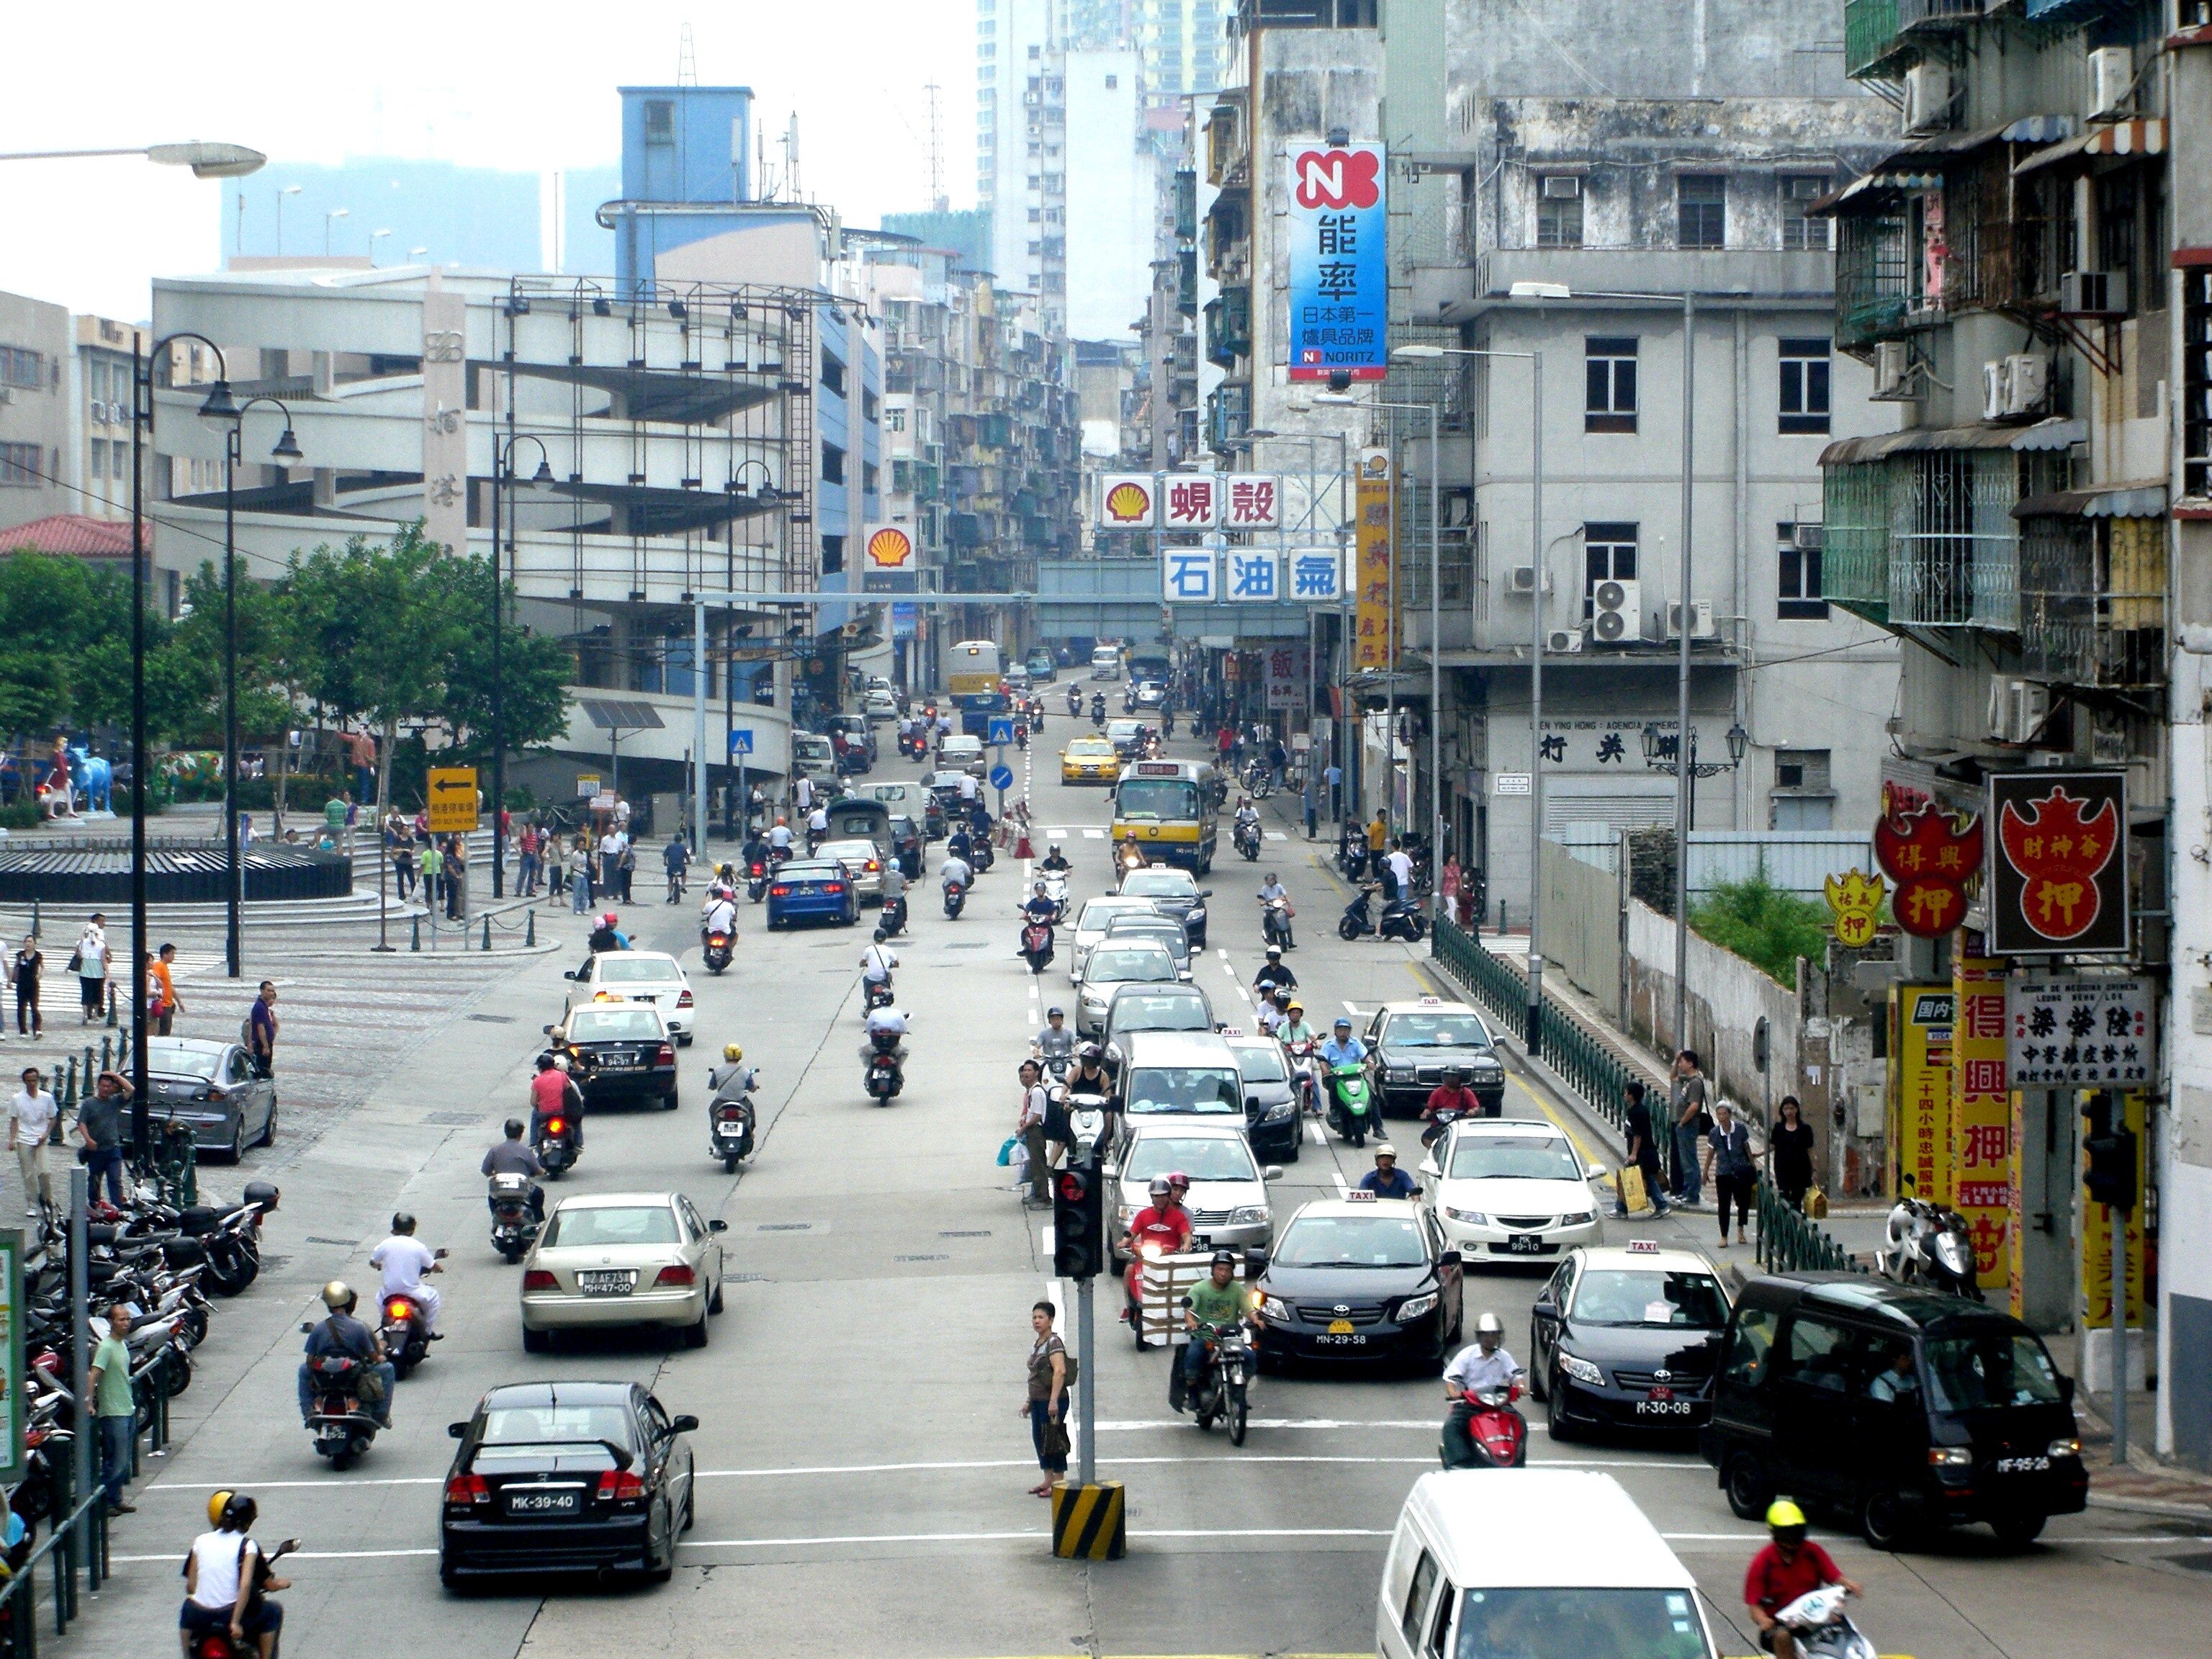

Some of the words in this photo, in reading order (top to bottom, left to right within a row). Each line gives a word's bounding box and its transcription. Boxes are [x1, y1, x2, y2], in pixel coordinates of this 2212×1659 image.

[1306, 161, 1341, 199] N
[1318, 215, 1357, 301] 能率
[1303, 307, 1374, 323] 日本第一
[1302, 328, 1374, 346] 爐具品牌
[1304, 352, 1313, 361] N
[1326, 351, 1375, 362] NORITZ
[1171, 482, 1274, 523] 蜆殼
[1171, 555, 1335, 596] 石油氣
[1529, 721, 1550, 730] LEN
[1555, 721, 1571, 730] YING
[1575, 721, 1596, 730] HONG
[1606, 721, 1642, 730] AGENCIA
[1896, 845, 1963, 871] 得興
[1908, 885, 1954, 928] 押
[2036, 880, 2083, 926] 押
[1844, 916, 1866, 939] 押
[1917, 1001, 1952, 1018] 国内
[1632, 1242, 1656, 1251] TAXI
[584, 1284, 631, 1292] MH-47-00
[1316, 1335, 1366, 1344] MN-29-58
[1637, 1401, 1691, 1414] M-30-08
[512, 1496, 574, 1510] MK-39-40
